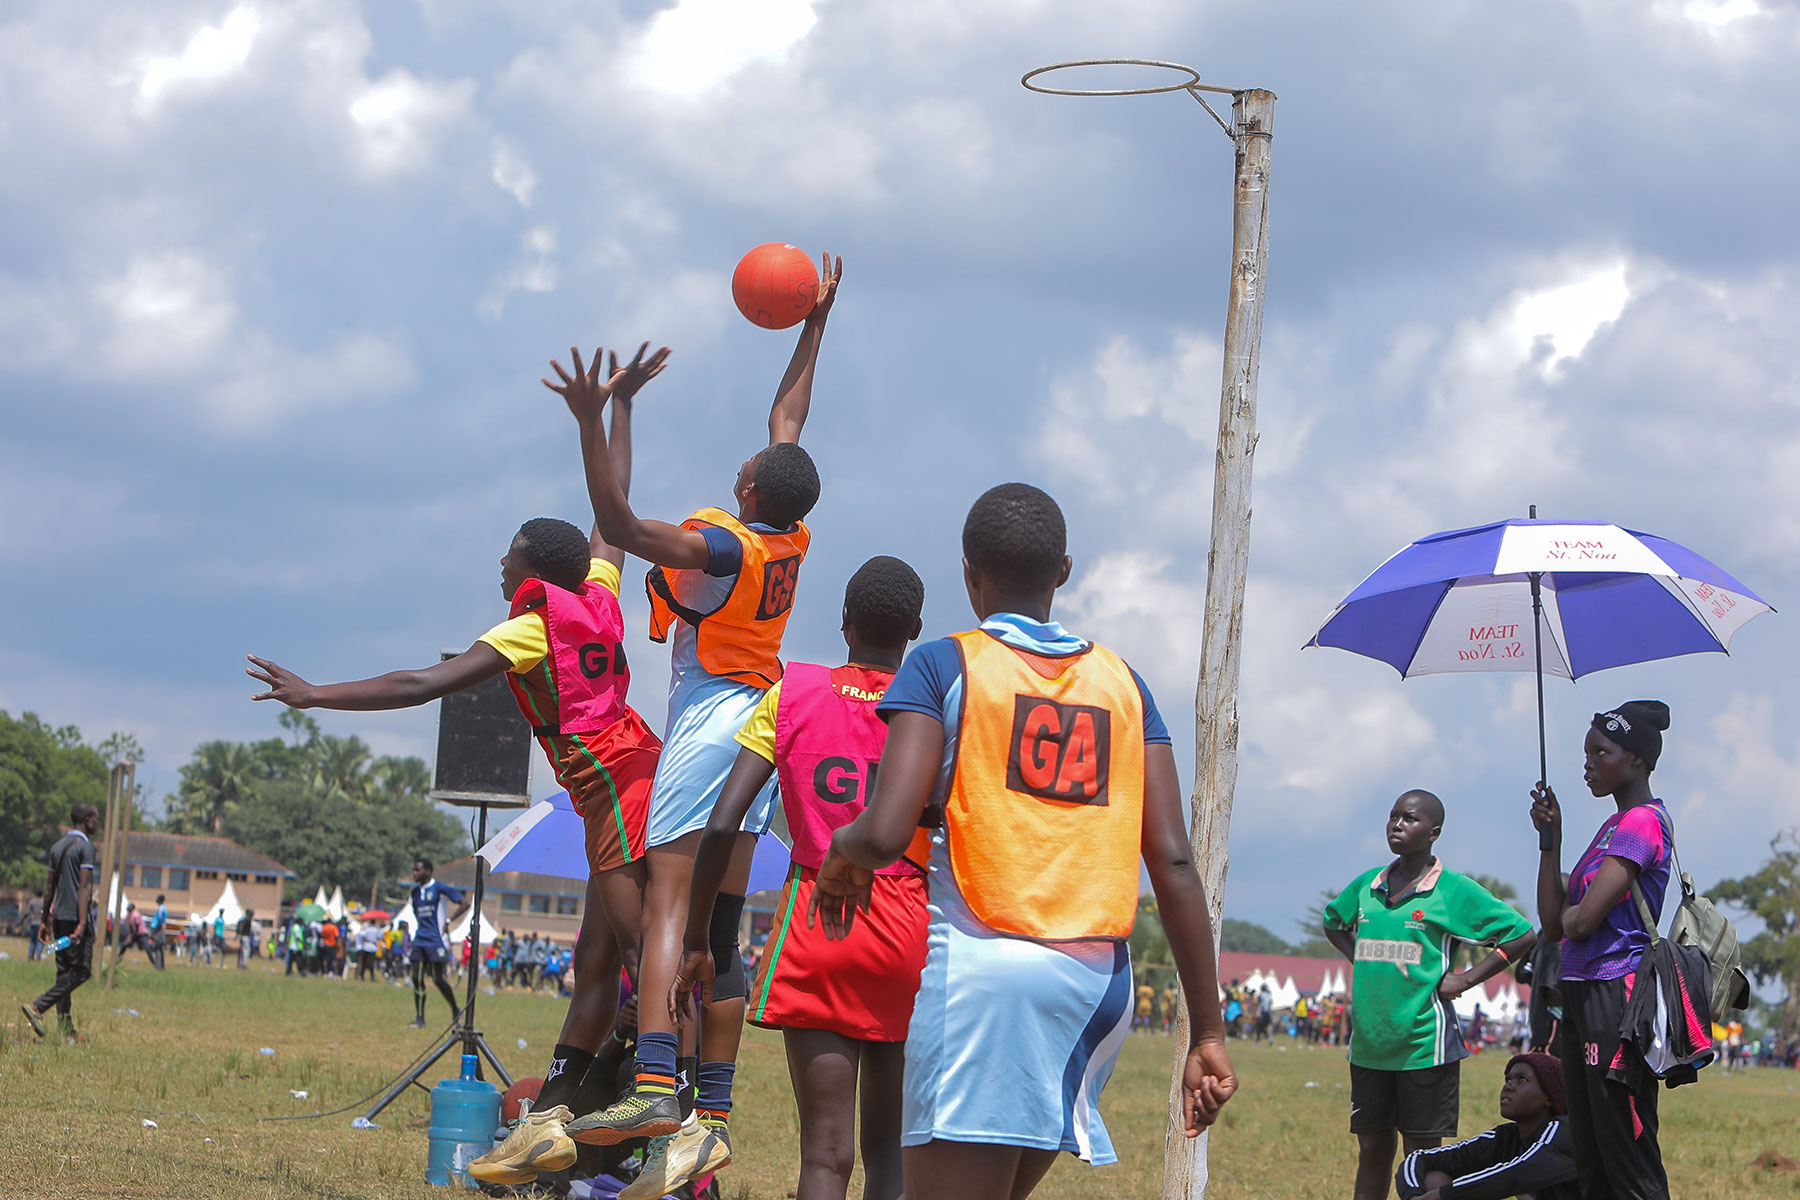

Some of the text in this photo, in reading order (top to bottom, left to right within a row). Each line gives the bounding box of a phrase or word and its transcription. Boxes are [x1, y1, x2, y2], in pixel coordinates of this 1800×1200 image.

[765, 560, 797, 615] GS
[1020, 704, 1098, 797] GA
[1584, 1041, 1599, 1066] 38
